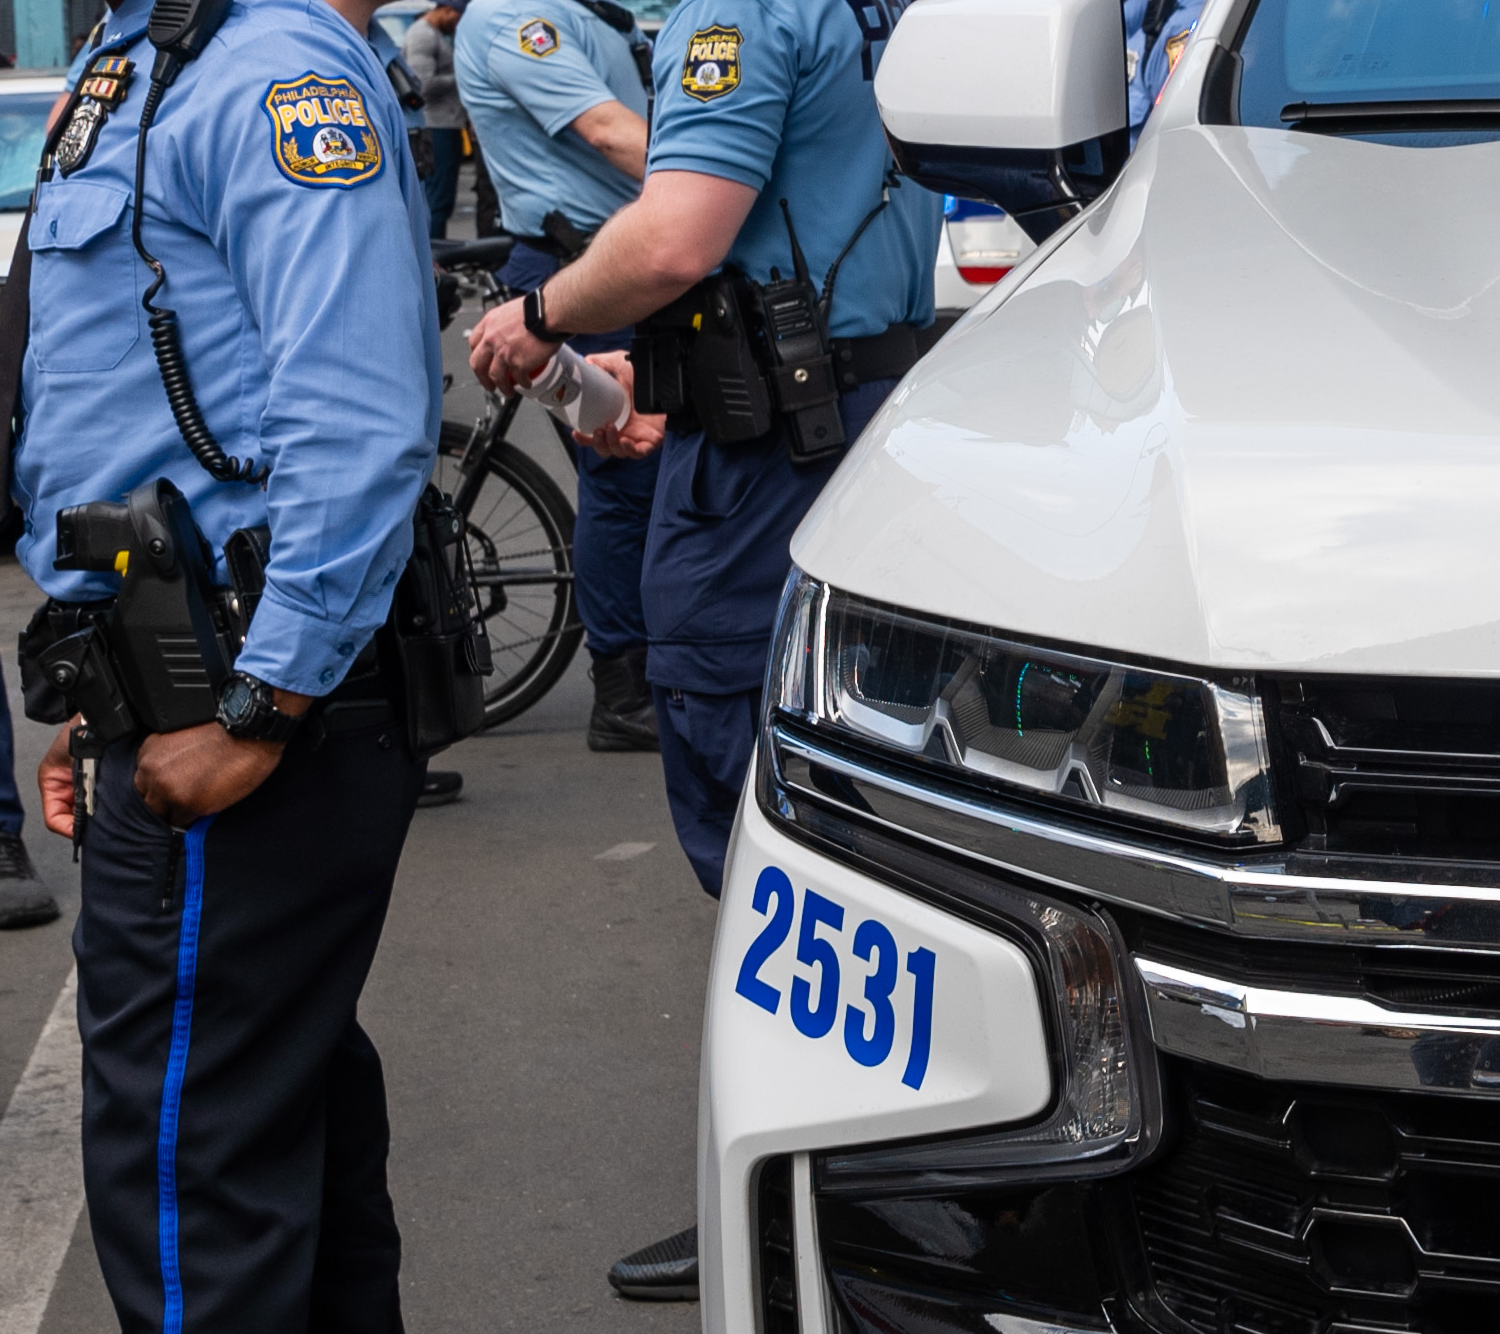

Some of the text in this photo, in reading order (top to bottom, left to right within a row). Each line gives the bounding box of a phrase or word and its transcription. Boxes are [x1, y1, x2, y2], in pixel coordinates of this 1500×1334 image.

[689, 41, 737, 63] POLICE
[277, 97, 367, 134] POLICE
[734, 865, 937, 1091] 2531
